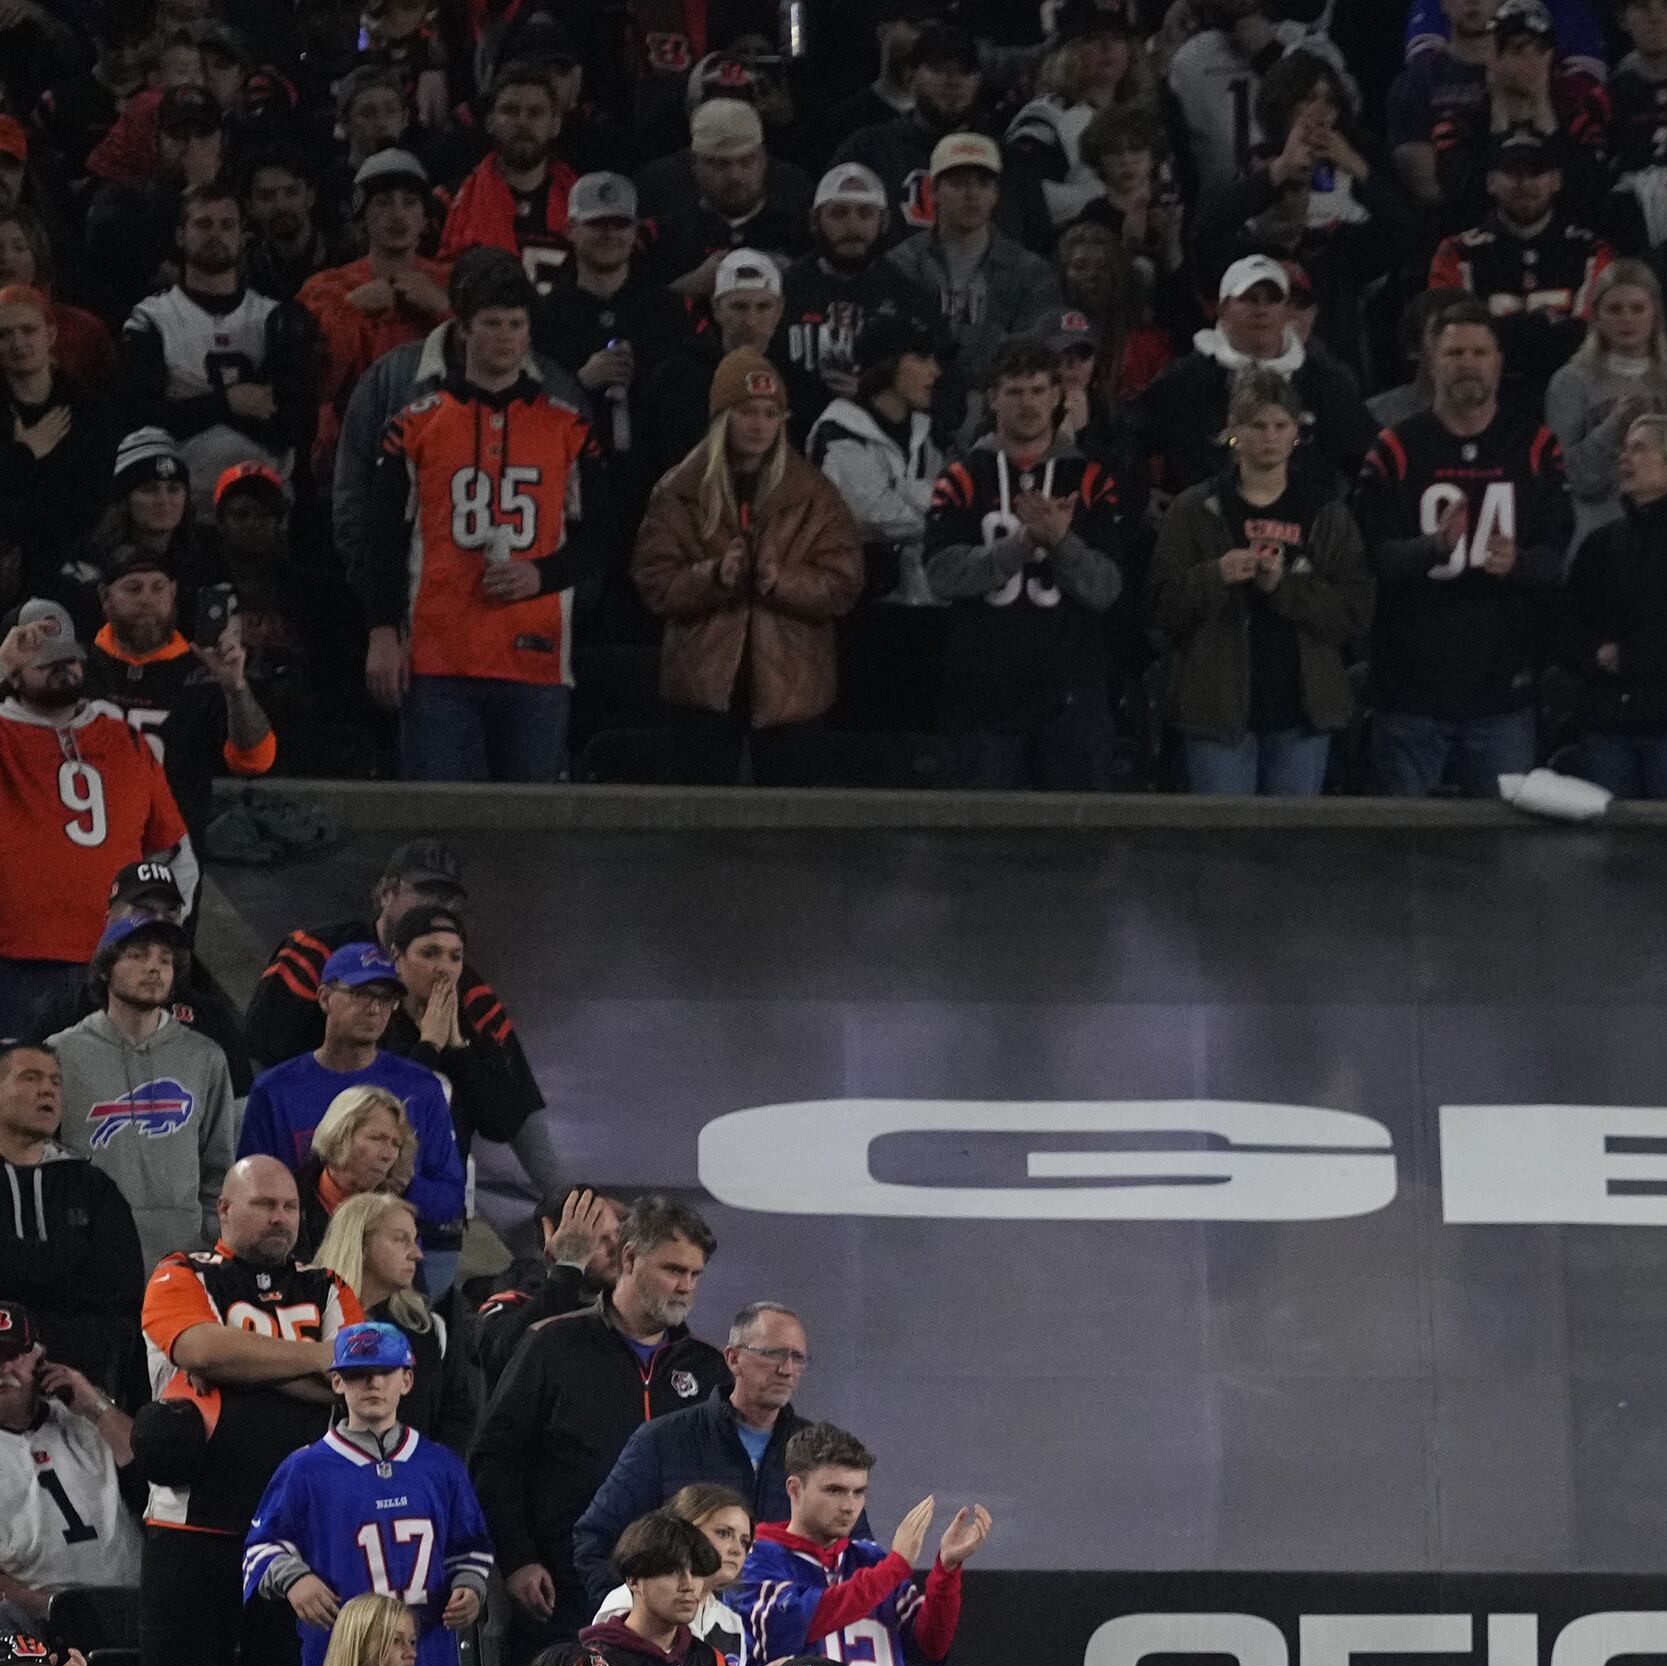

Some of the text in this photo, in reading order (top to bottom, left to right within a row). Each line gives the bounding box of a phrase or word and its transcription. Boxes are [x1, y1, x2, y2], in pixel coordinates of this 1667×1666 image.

[450, 466, 542, 552] 85
[58, 760, 108, 848] 9
[136, 862, 172, 883] CIN
[36, 1468, 99, 1545] 1
[375, 1496, 408, 1511] BILLS
[356, 1518, 435, 1606] 17
